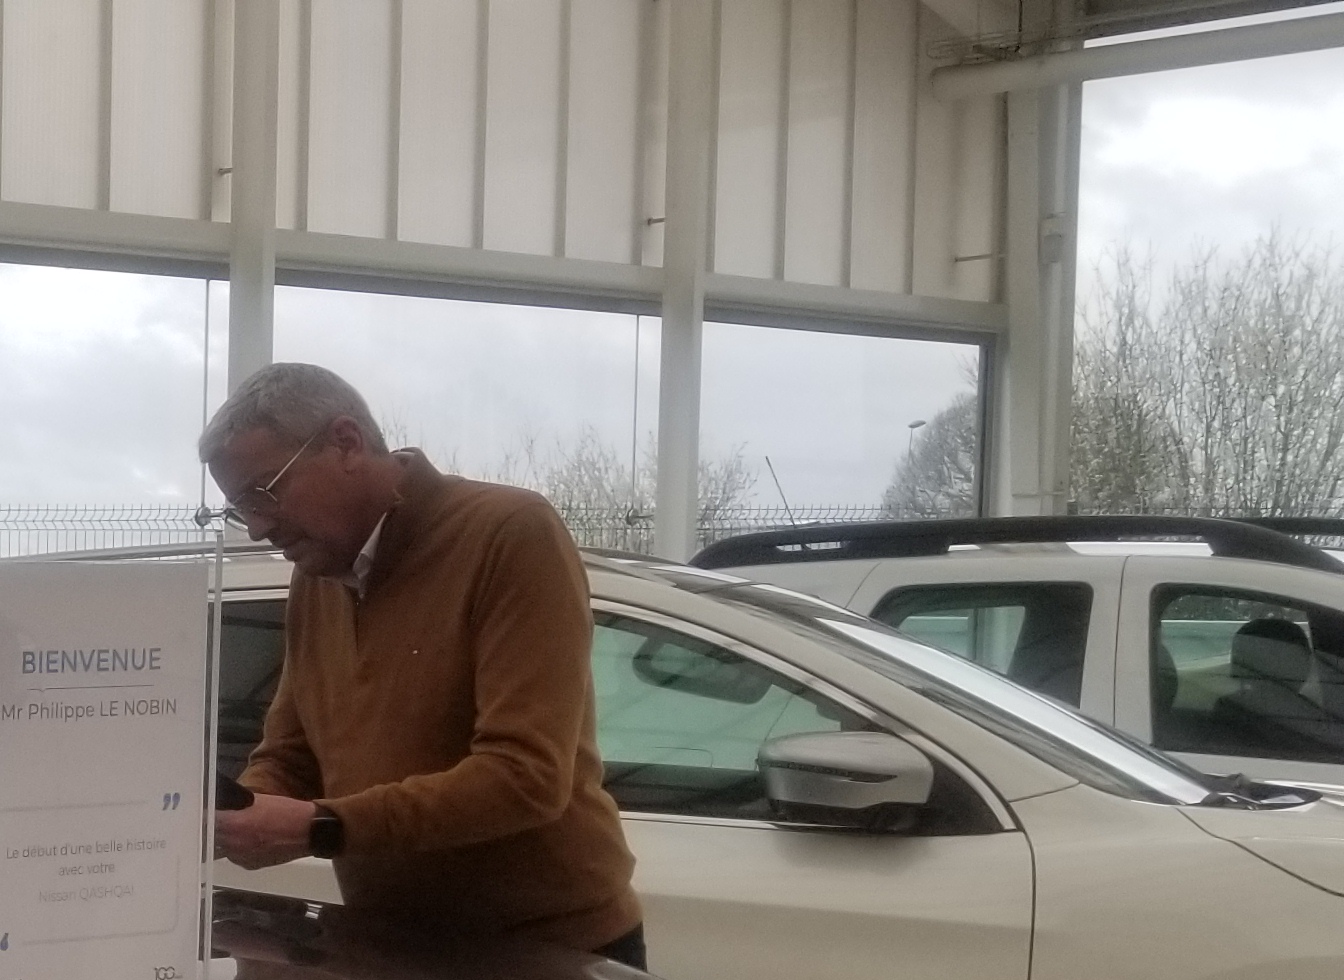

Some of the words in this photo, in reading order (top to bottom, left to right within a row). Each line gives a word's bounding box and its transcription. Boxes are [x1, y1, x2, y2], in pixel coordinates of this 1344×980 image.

[21, 647, 162, 674] BIENVENUE
[1, 703, 22, 721] Mr
[28, 701, 95, 723] Philippe
[99, 700, 119, 717] LE
[124, 698, 177, 716] NOBIN
[6, 846, 19, 859] Le
[22, 843, 57, 858] début
[60, 842, 92, 856] d'une
[96, 840, 123, 853] belle
[126, 837, 167, 852] histoire
[58, 864, 82, 876] avec
[87, 862, 115, 875] votre
